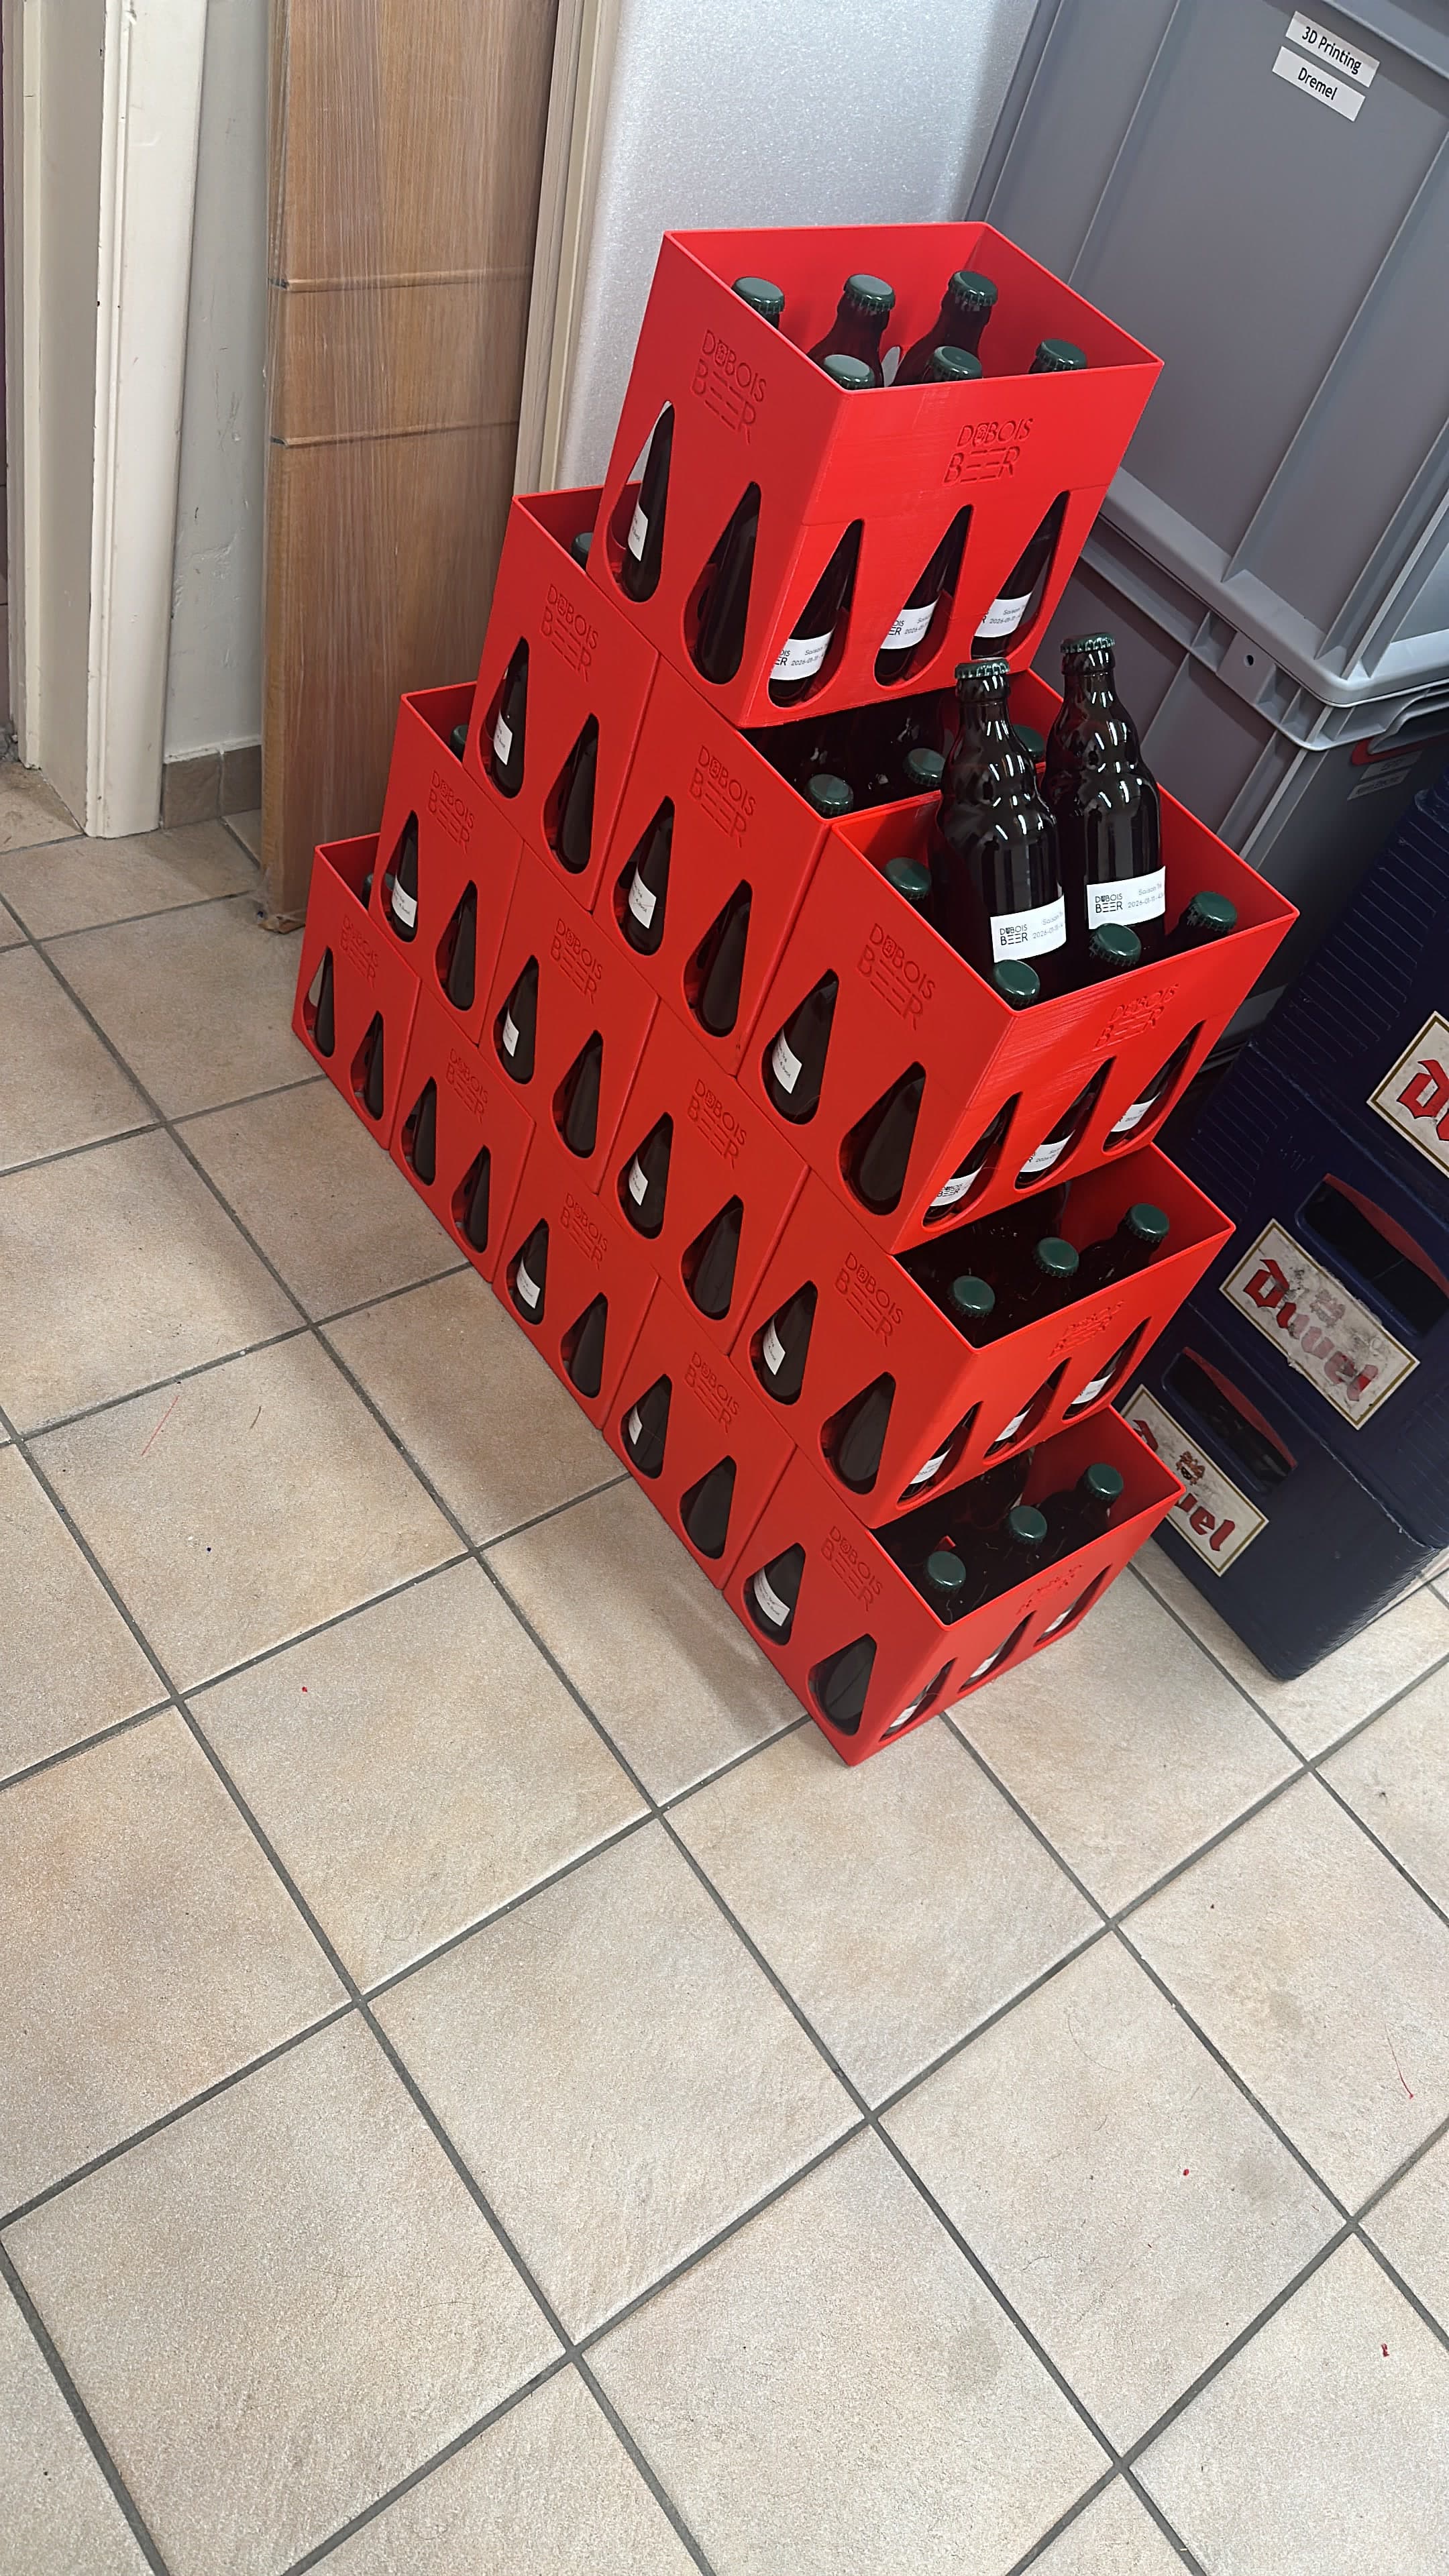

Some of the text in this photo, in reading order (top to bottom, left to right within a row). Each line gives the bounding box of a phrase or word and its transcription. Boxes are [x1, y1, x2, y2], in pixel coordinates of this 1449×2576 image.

[1301, 26, 1361, 74] 3D Printing
[1297, 67, 1338, 100] Dremel
[1095, 901, 1123, 914] BEER
[1000, 932, 1028, 946] BEER
